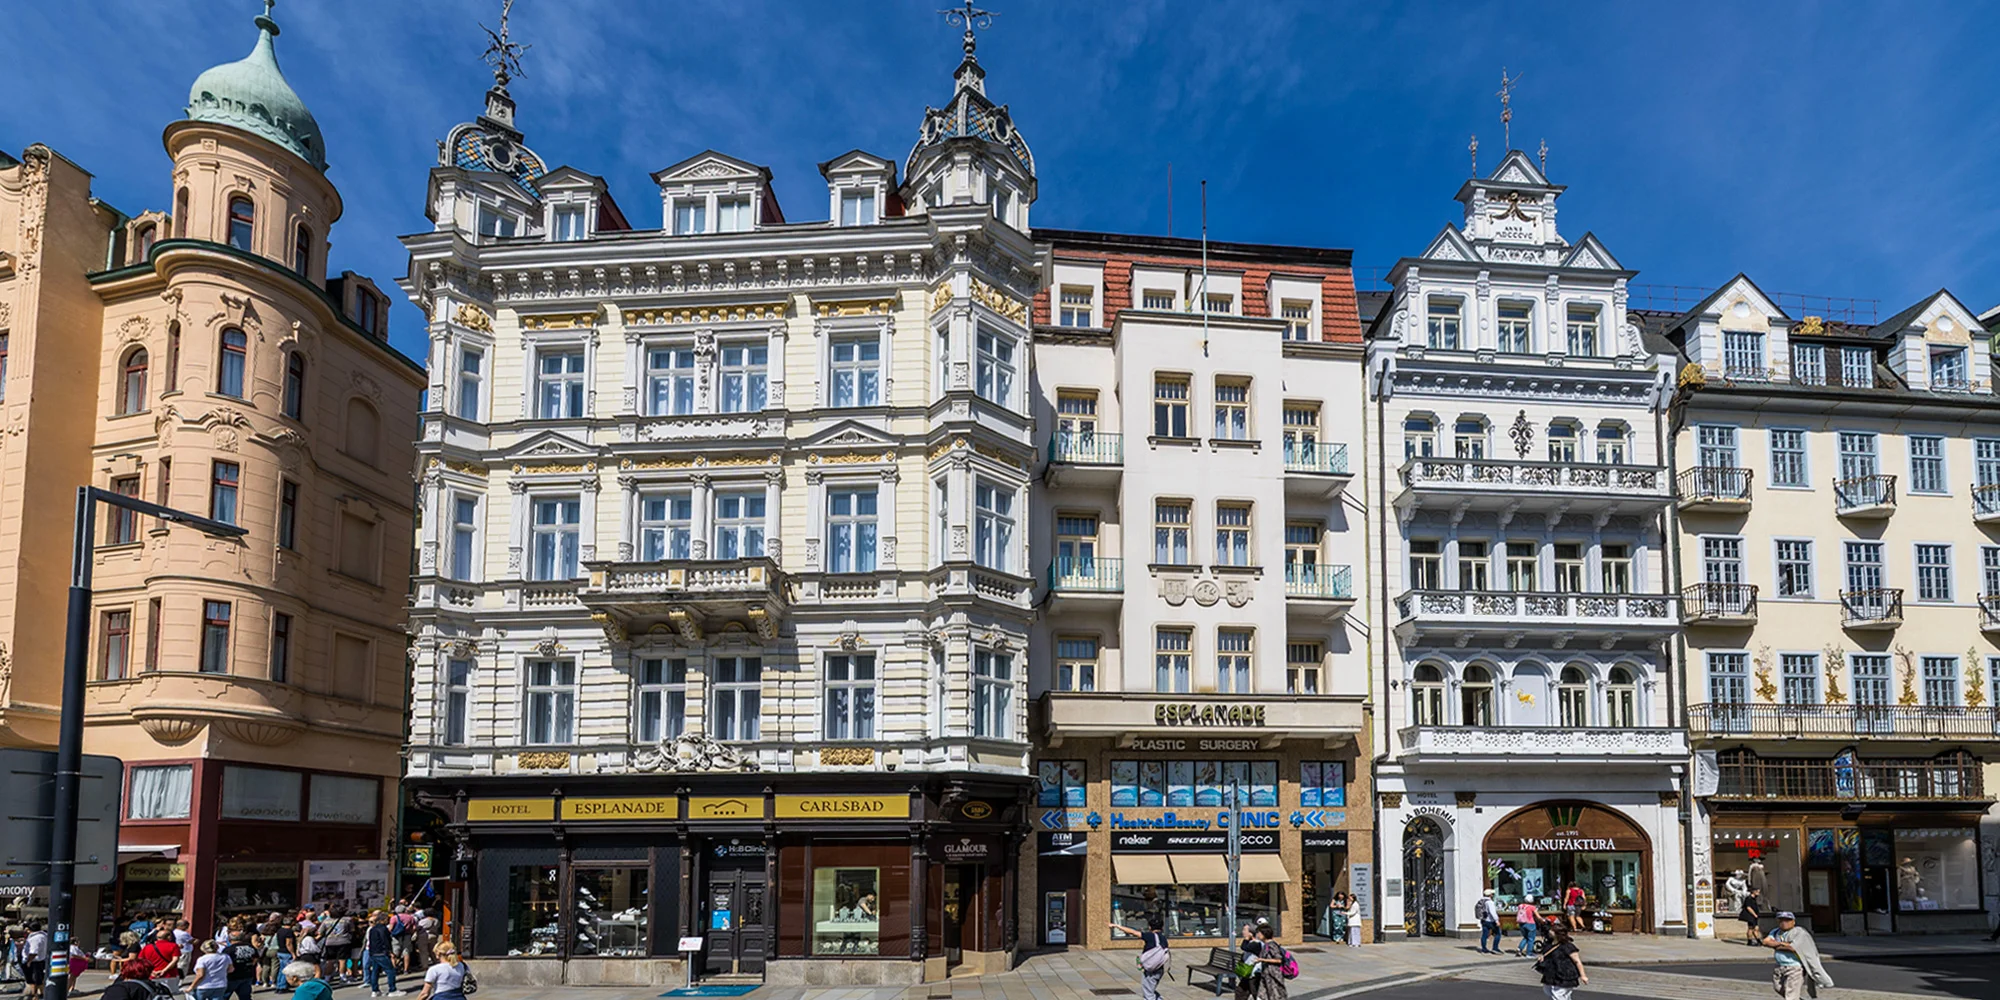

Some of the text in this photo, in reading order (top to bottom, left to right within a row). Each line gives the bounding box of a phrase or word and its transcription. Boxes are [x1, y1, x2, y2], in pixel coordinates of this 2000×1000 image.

[1155, 704, 1266, 721] ESPLANADE
[1132, 740, 1259, 750] PLASTIC SURGERY
[491, 804, 531, 814] HOTEL
[575, 801, 665, 815] ESPLANADE
[800, 800, 884, 813] CARLSBAD
[1217, 811, 1280, 828] CINIC
[1400, 806, 1456, 826] LA BOHEMIA
[1052, 833, 1072, 841] ATM
[944, 844, 988, 853] GLAMOUR
[1520, 838, 1616, 850] MANUFAKTURA
[1734, 839, 1759, 849] TOTAL
